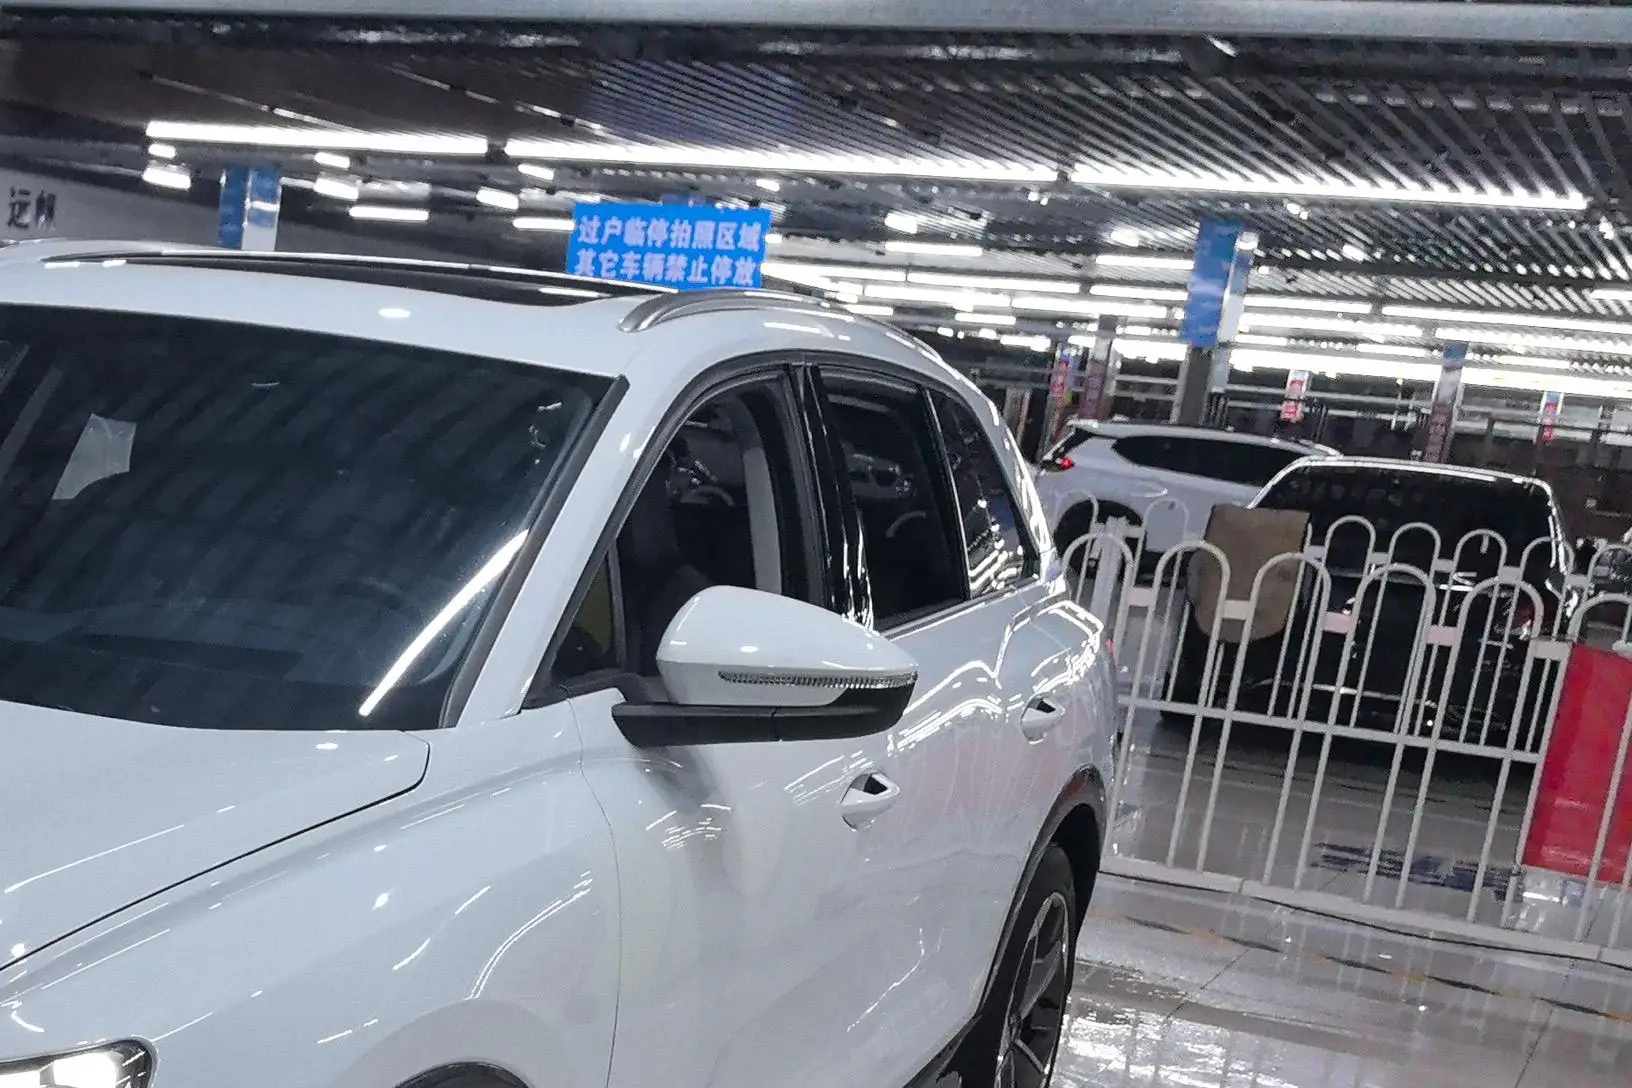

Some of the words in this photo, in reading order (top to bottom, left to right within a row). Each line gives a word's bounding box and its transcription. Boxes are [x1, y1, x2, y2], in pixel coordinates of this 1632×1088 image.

[578, 215, 762, 252] 过户临停拍照区域
